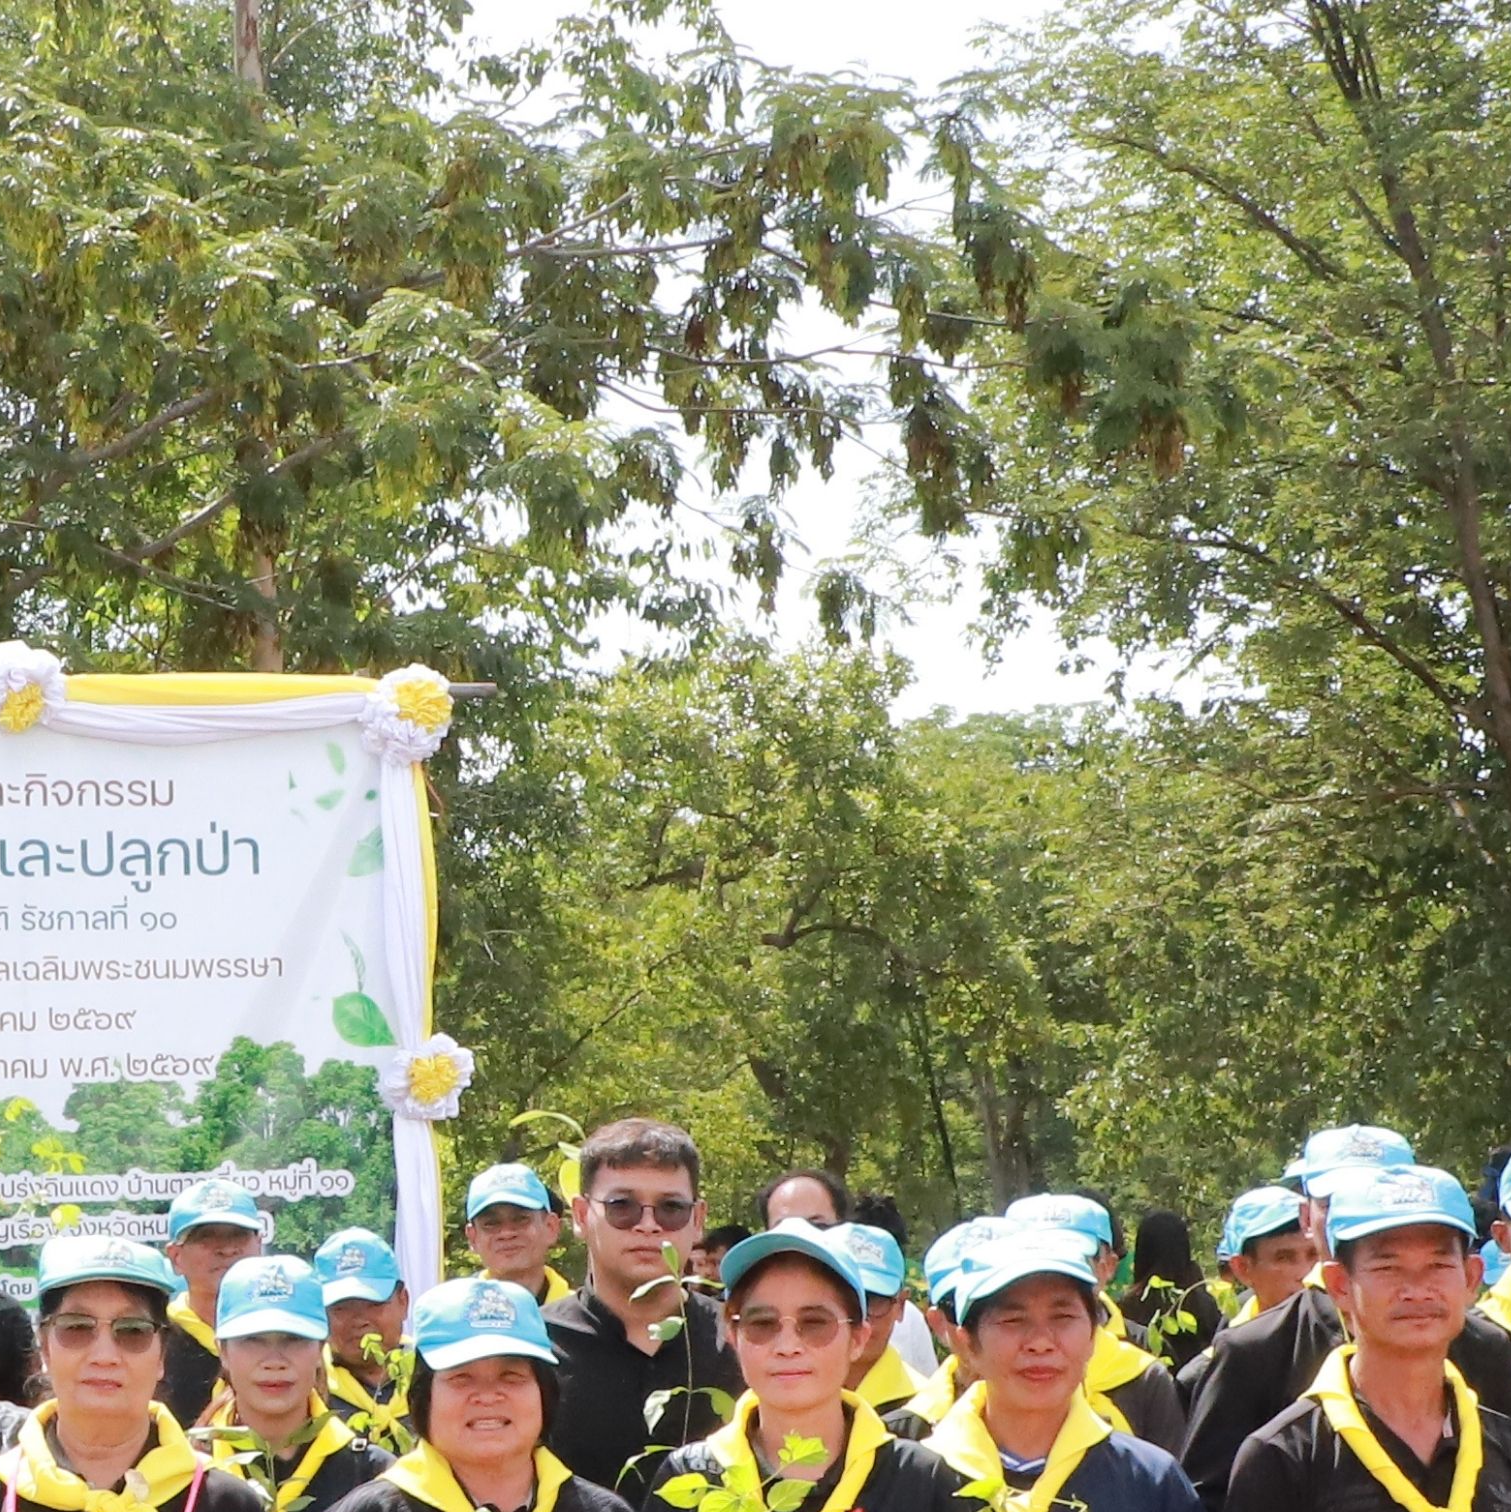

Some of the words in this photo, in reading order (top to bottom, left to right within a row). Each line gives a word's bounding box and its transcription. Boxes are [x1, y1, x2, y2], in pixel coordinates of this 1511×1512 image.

[20, 896, 129, 932] รัชกาลที่
[141, 911, 178, 932] ๑๐
[49, 1006, 137, 1033] ๒๕๖๙
[126, 1051, 216, 1077] ๒๕๖๙
[269, 1163, 313, 1196] หมู่ที่
[0, 1279, 33, 1296] โดย
